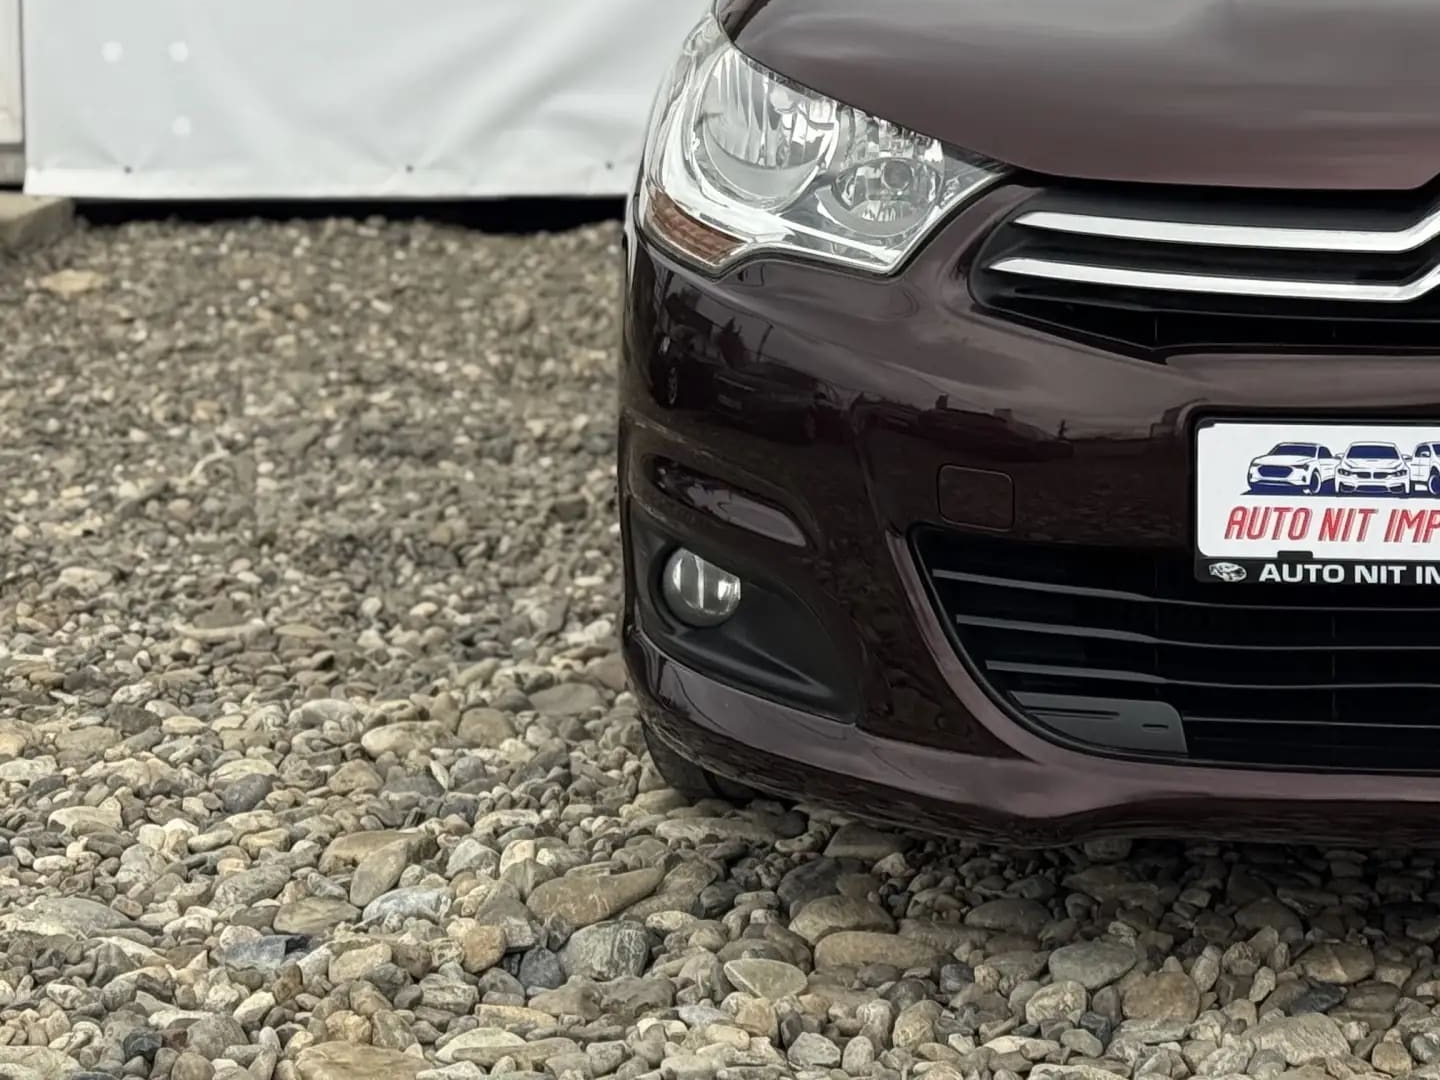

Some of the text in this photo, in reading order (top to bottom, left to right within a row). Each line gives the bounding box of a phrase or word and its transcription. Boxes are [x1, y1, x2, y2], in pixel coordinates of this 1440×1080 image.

[1224, 506, 1310, 541] AUTO
[1317, 508, 1379, 543] NIT
[1258, 563, 1345, 584] AUTO
[1354, 565, 1405, 584] NIT
